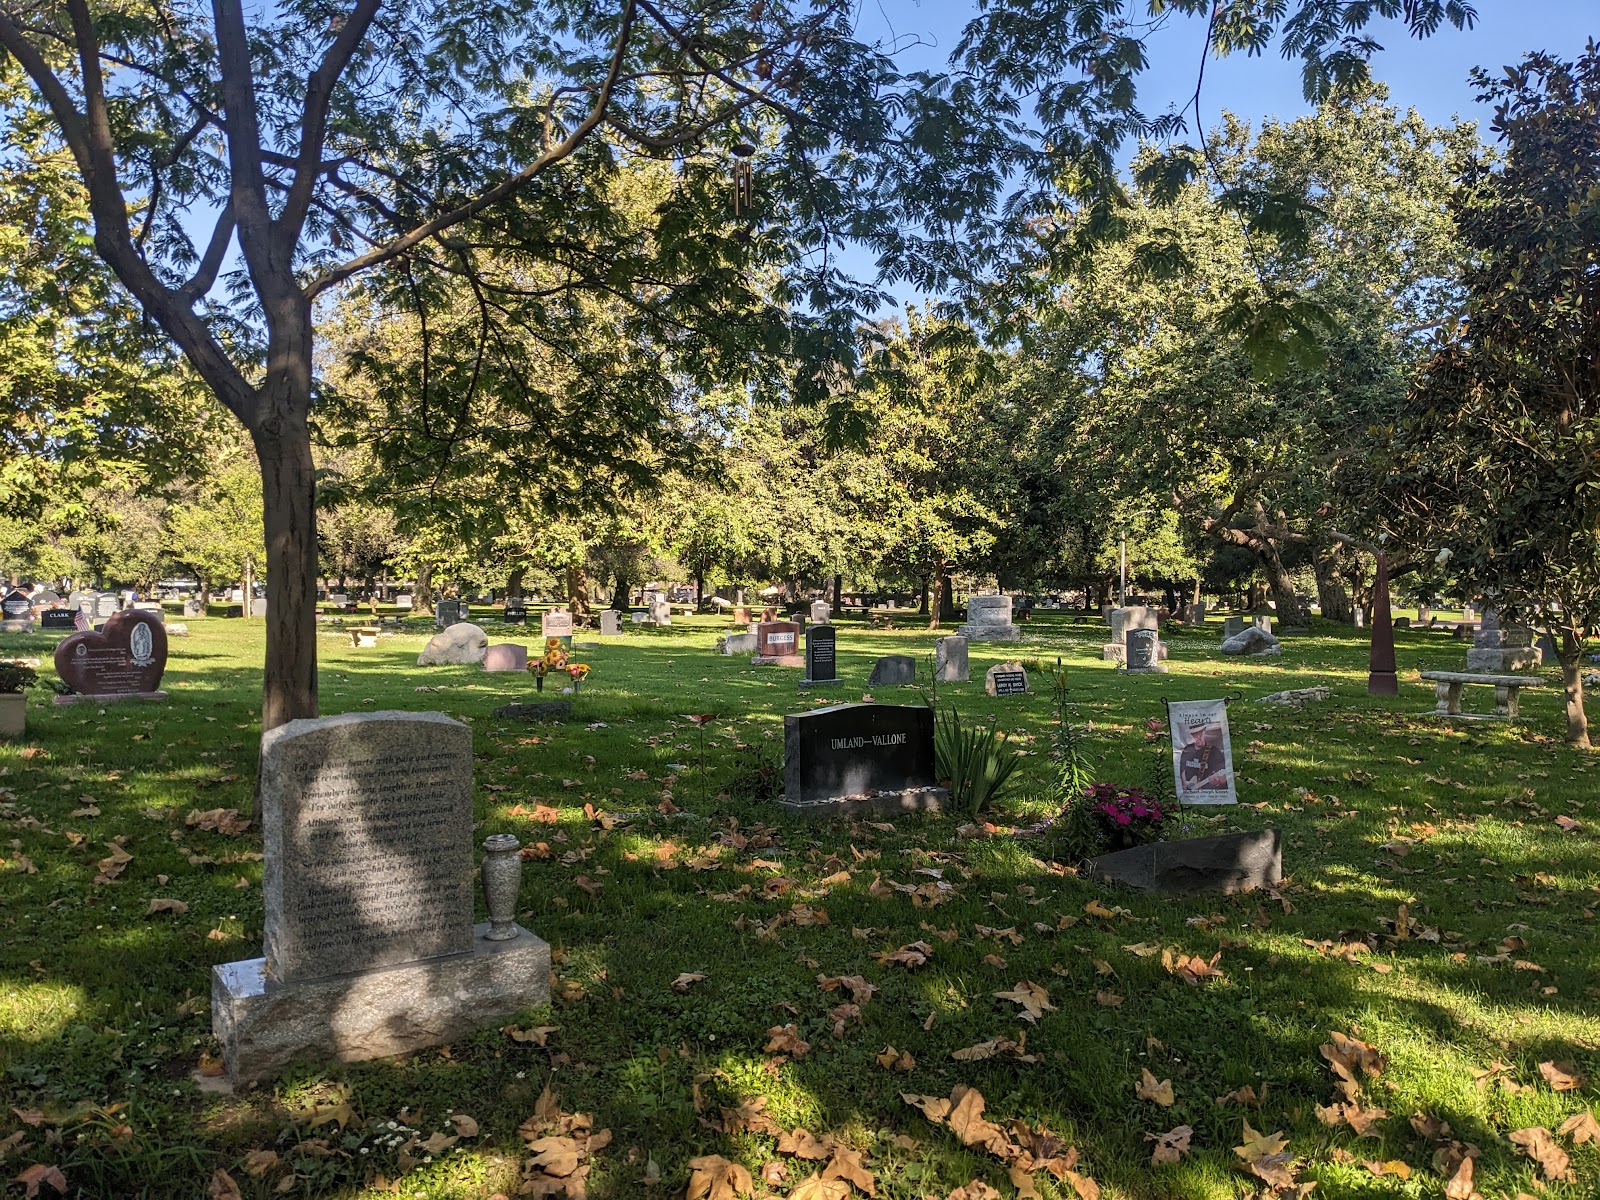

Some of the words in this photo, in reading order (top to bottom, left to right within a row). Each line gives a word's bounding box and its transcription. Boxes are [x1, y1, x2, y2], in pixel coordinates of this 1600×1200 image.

[1184, 716, 1212, 725] Hearts
[301, 790, 344, 799] Remember
[347, 787, 359, 795] the
[416, 781, 428, 789] the
[360, 813, 390, 822] leaving
